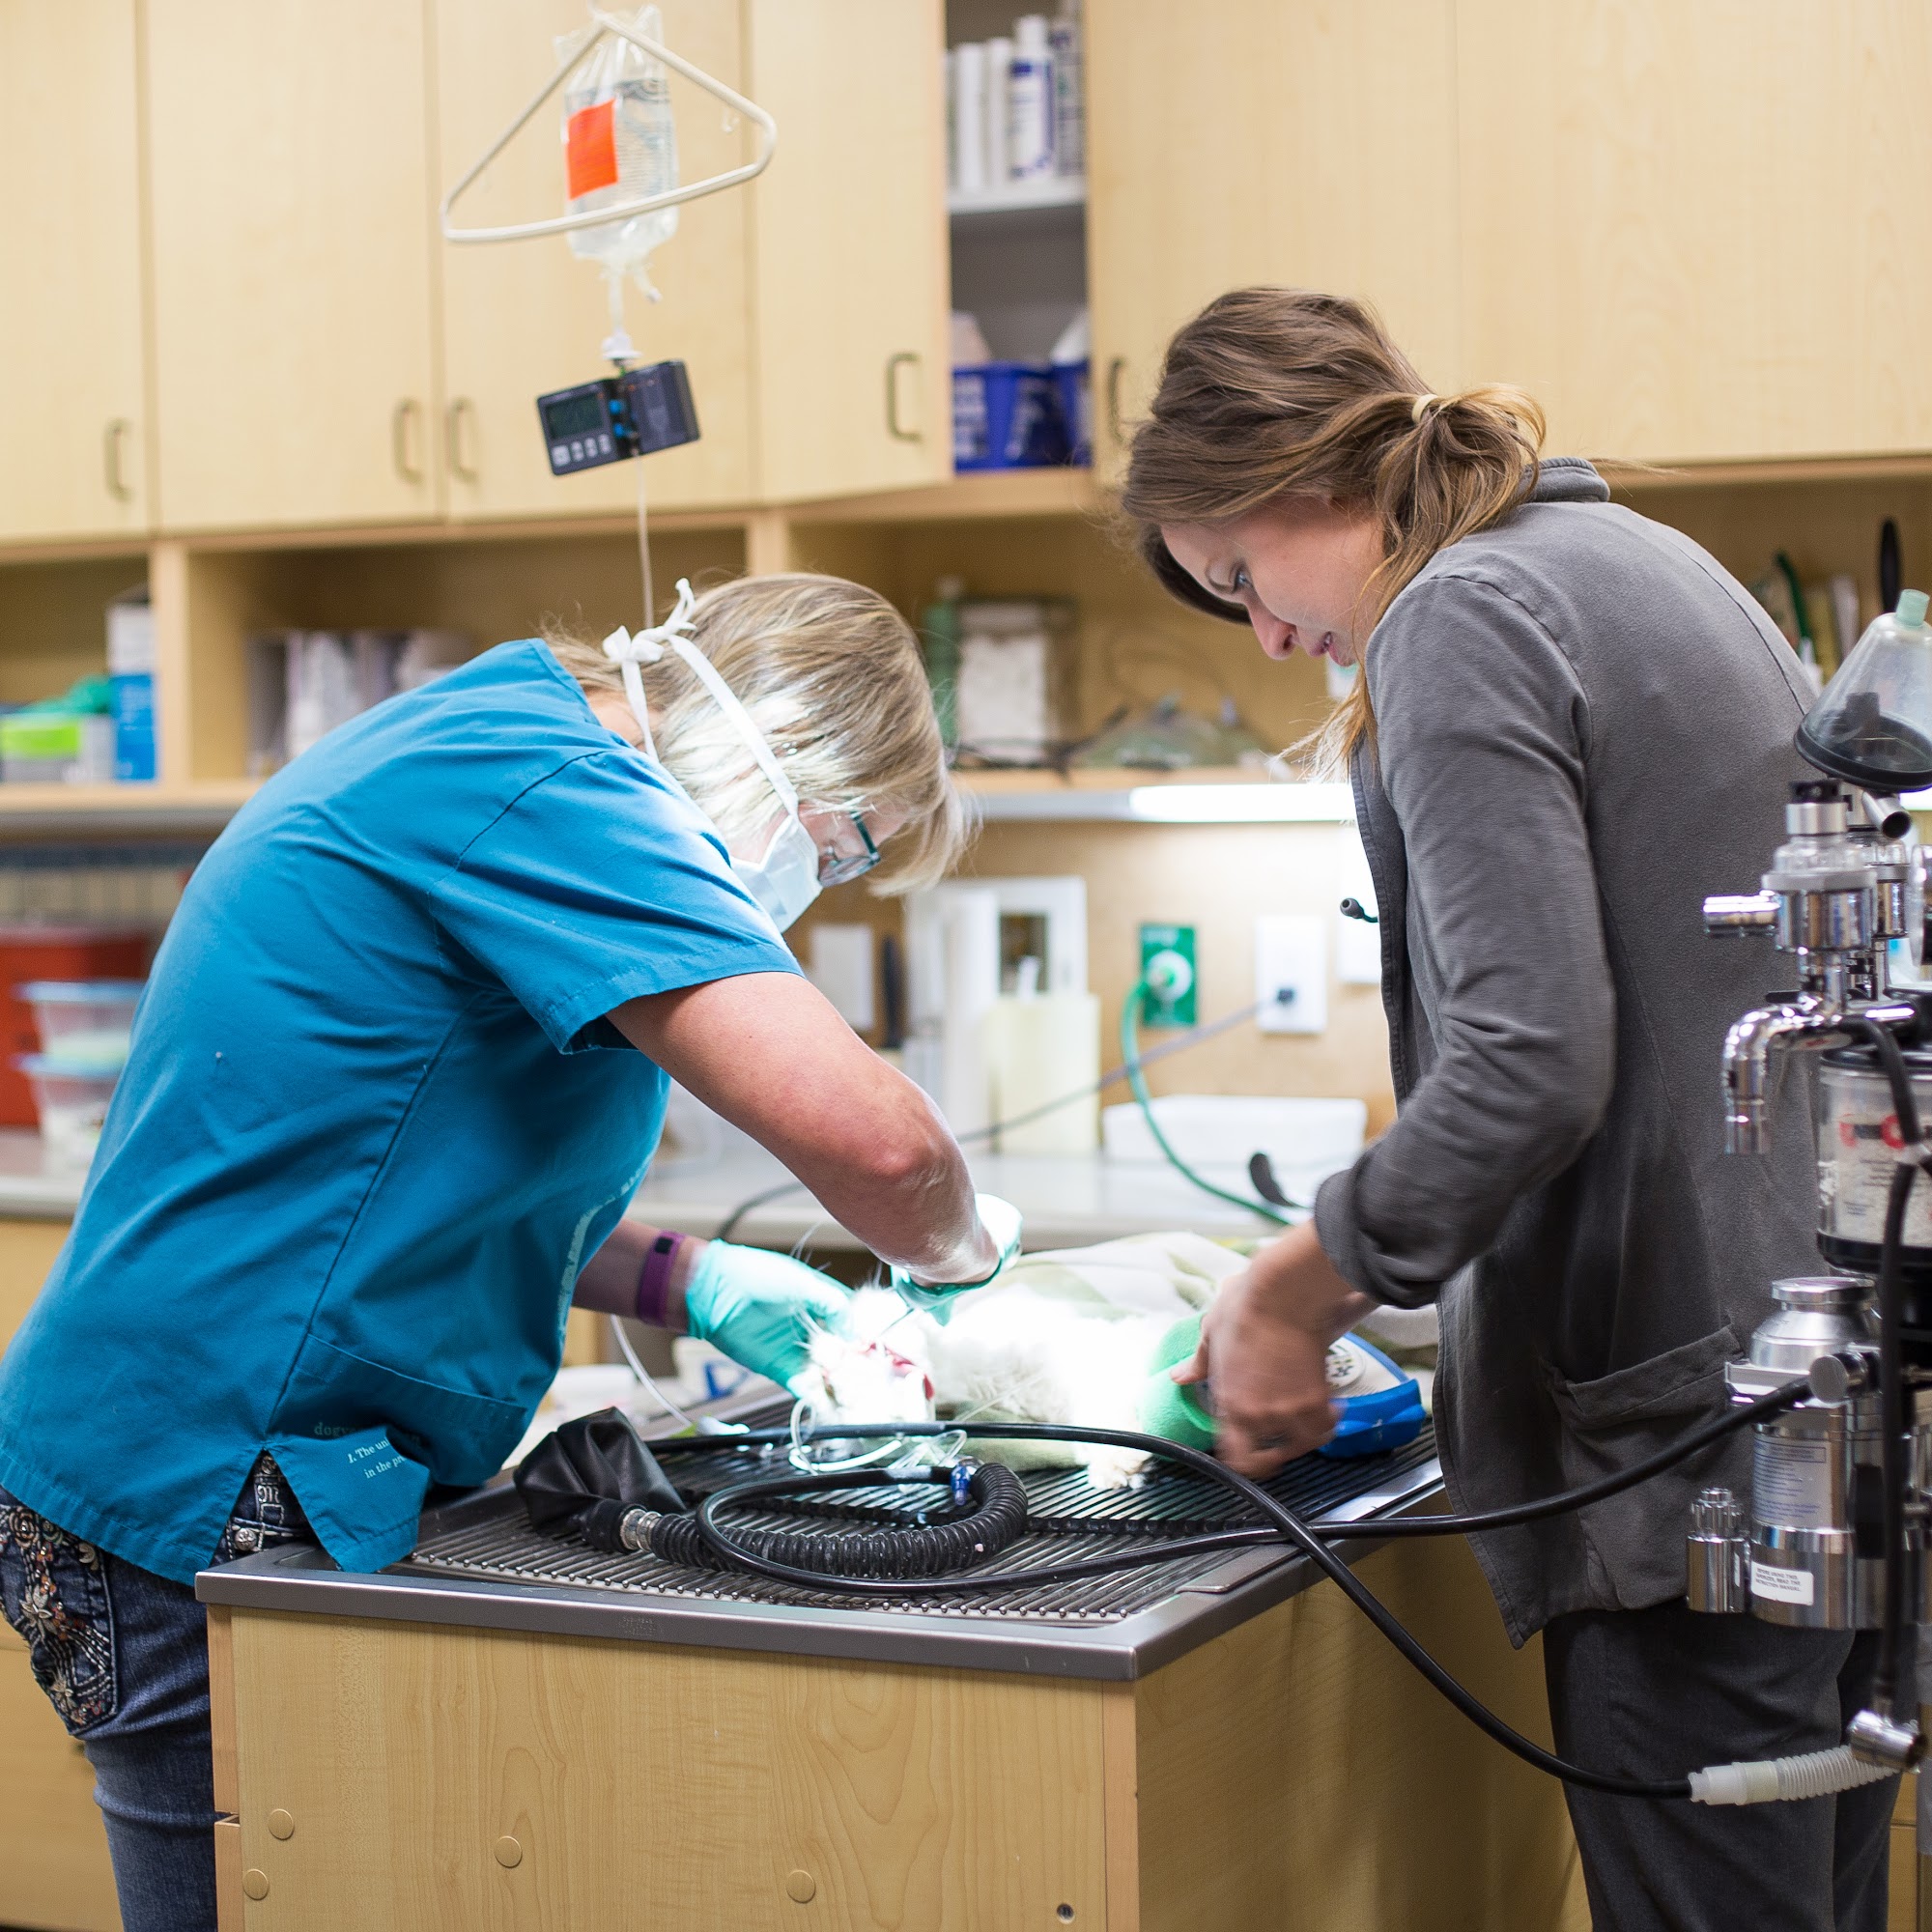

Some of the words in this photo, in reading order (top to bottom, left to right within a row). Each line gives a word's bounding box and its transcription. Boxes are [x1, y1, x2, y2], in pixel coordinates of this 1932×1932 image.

[355, 1445, 376, 1459] The
[363, 1468, 377, 1479] in
[375, 1461, 392, 1473] the
